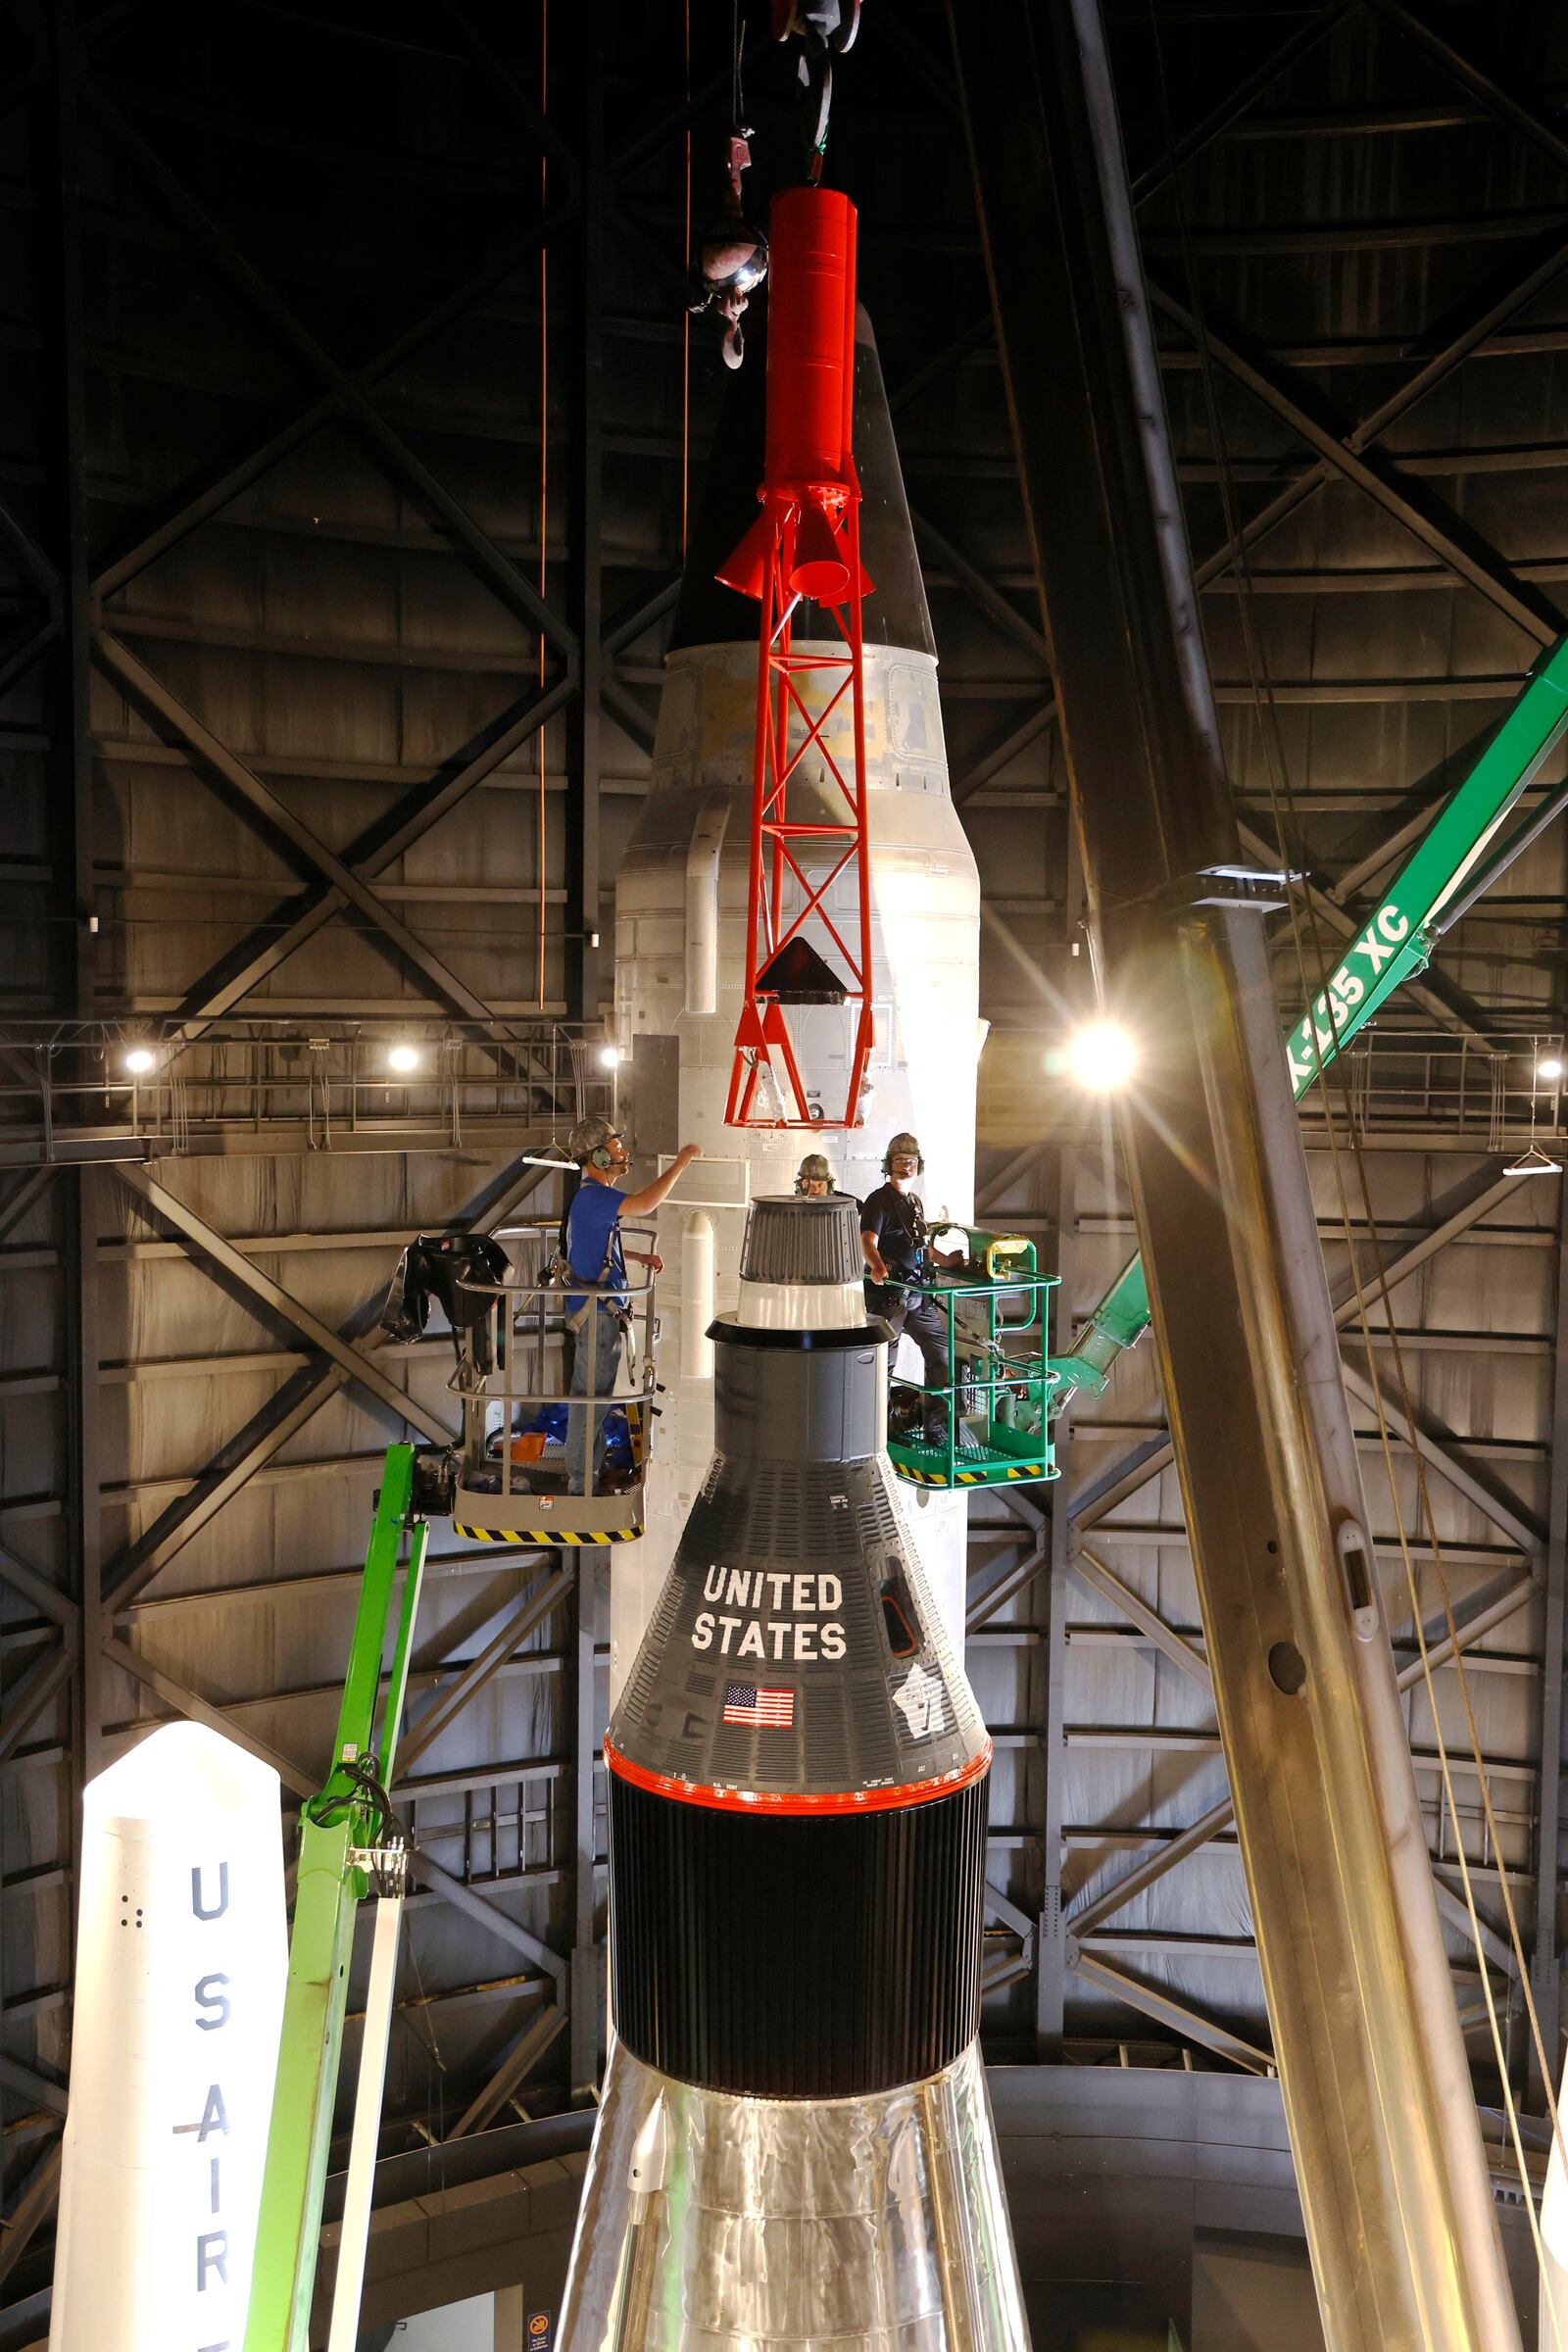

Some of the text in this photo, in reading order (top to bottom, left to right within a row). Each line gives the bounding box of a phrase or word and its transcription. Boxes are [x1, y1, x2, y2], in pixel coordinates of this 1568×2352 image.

[1353, 905, 1408, 975] XC
[704, 1565, 843, 1611] UNITED
[691, 1612, 847, 1660] STATES
